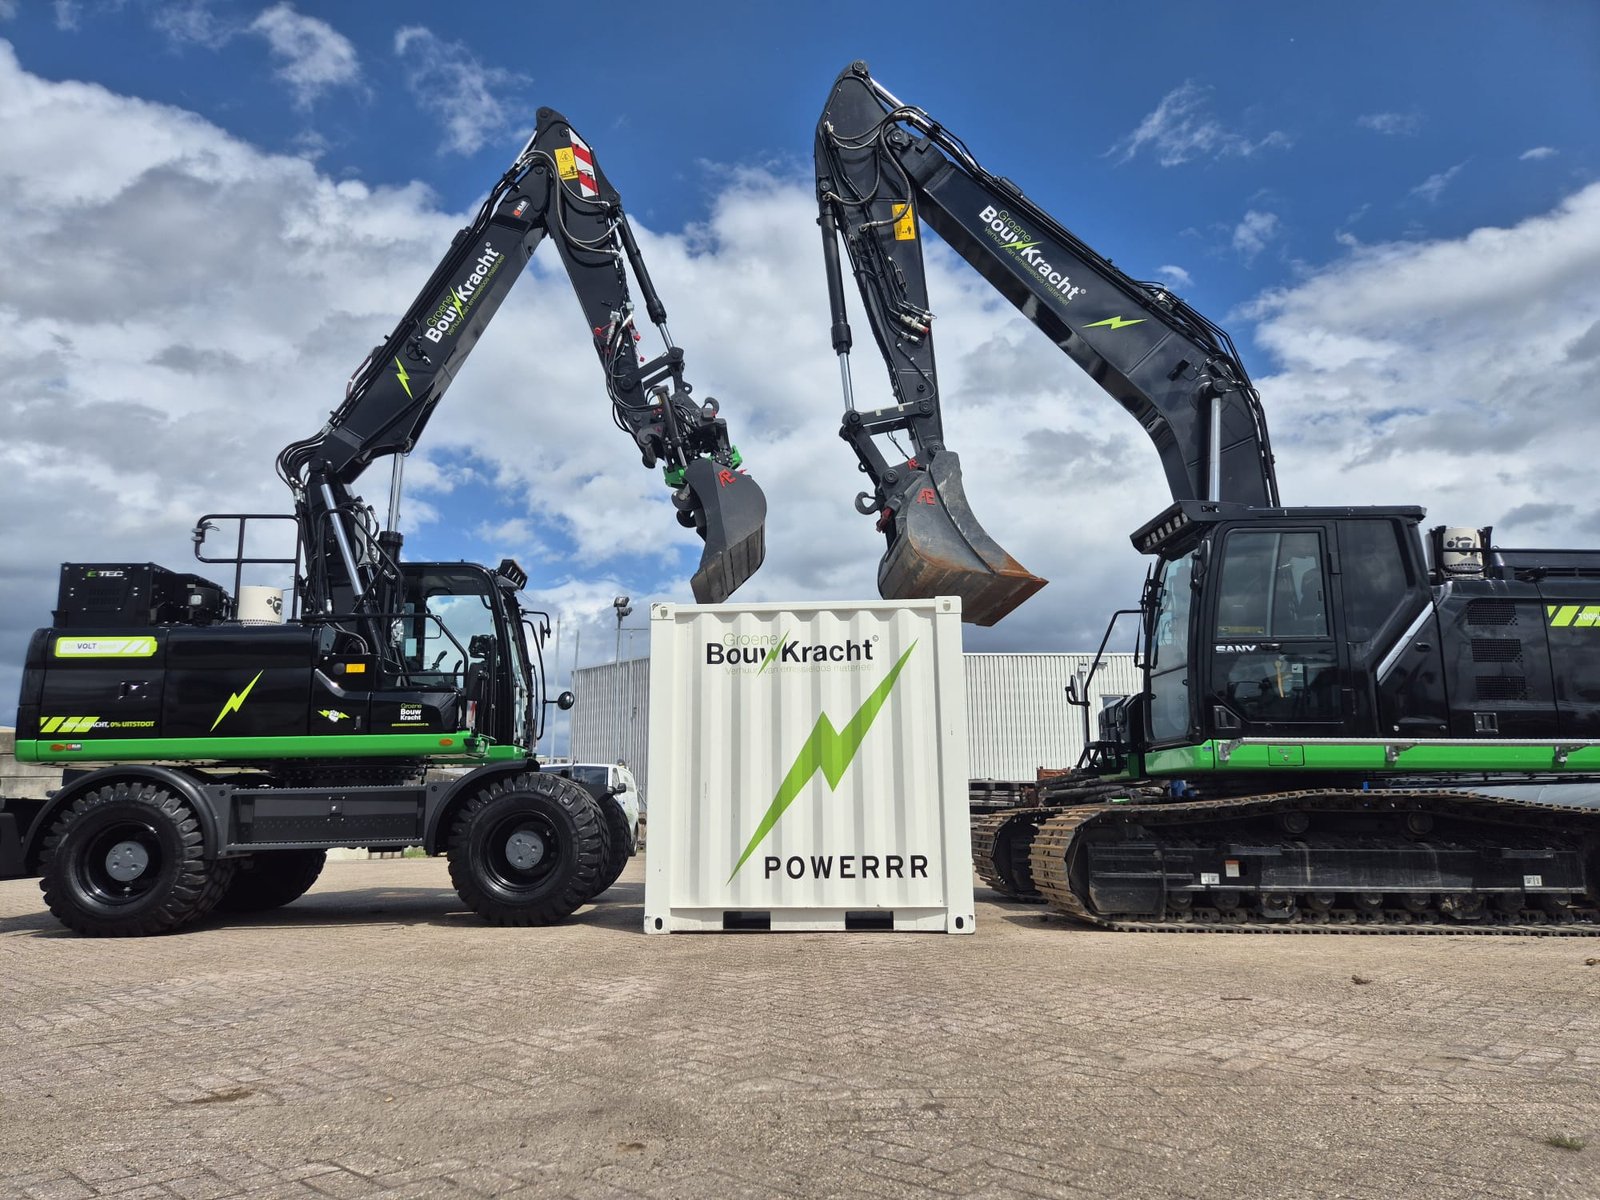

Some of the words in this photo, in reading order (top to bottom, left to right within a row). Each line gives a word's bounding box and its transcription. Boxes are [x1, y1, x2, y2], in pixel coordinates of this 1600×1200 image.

[999, 210, 1031, 242] Groene
[426, 295, 454, 327] Groene
[723, 633, 778, 647] Groene
[1215, 645, 1256, 653] SANY
[764, 855, 928, 879] POWERRR
